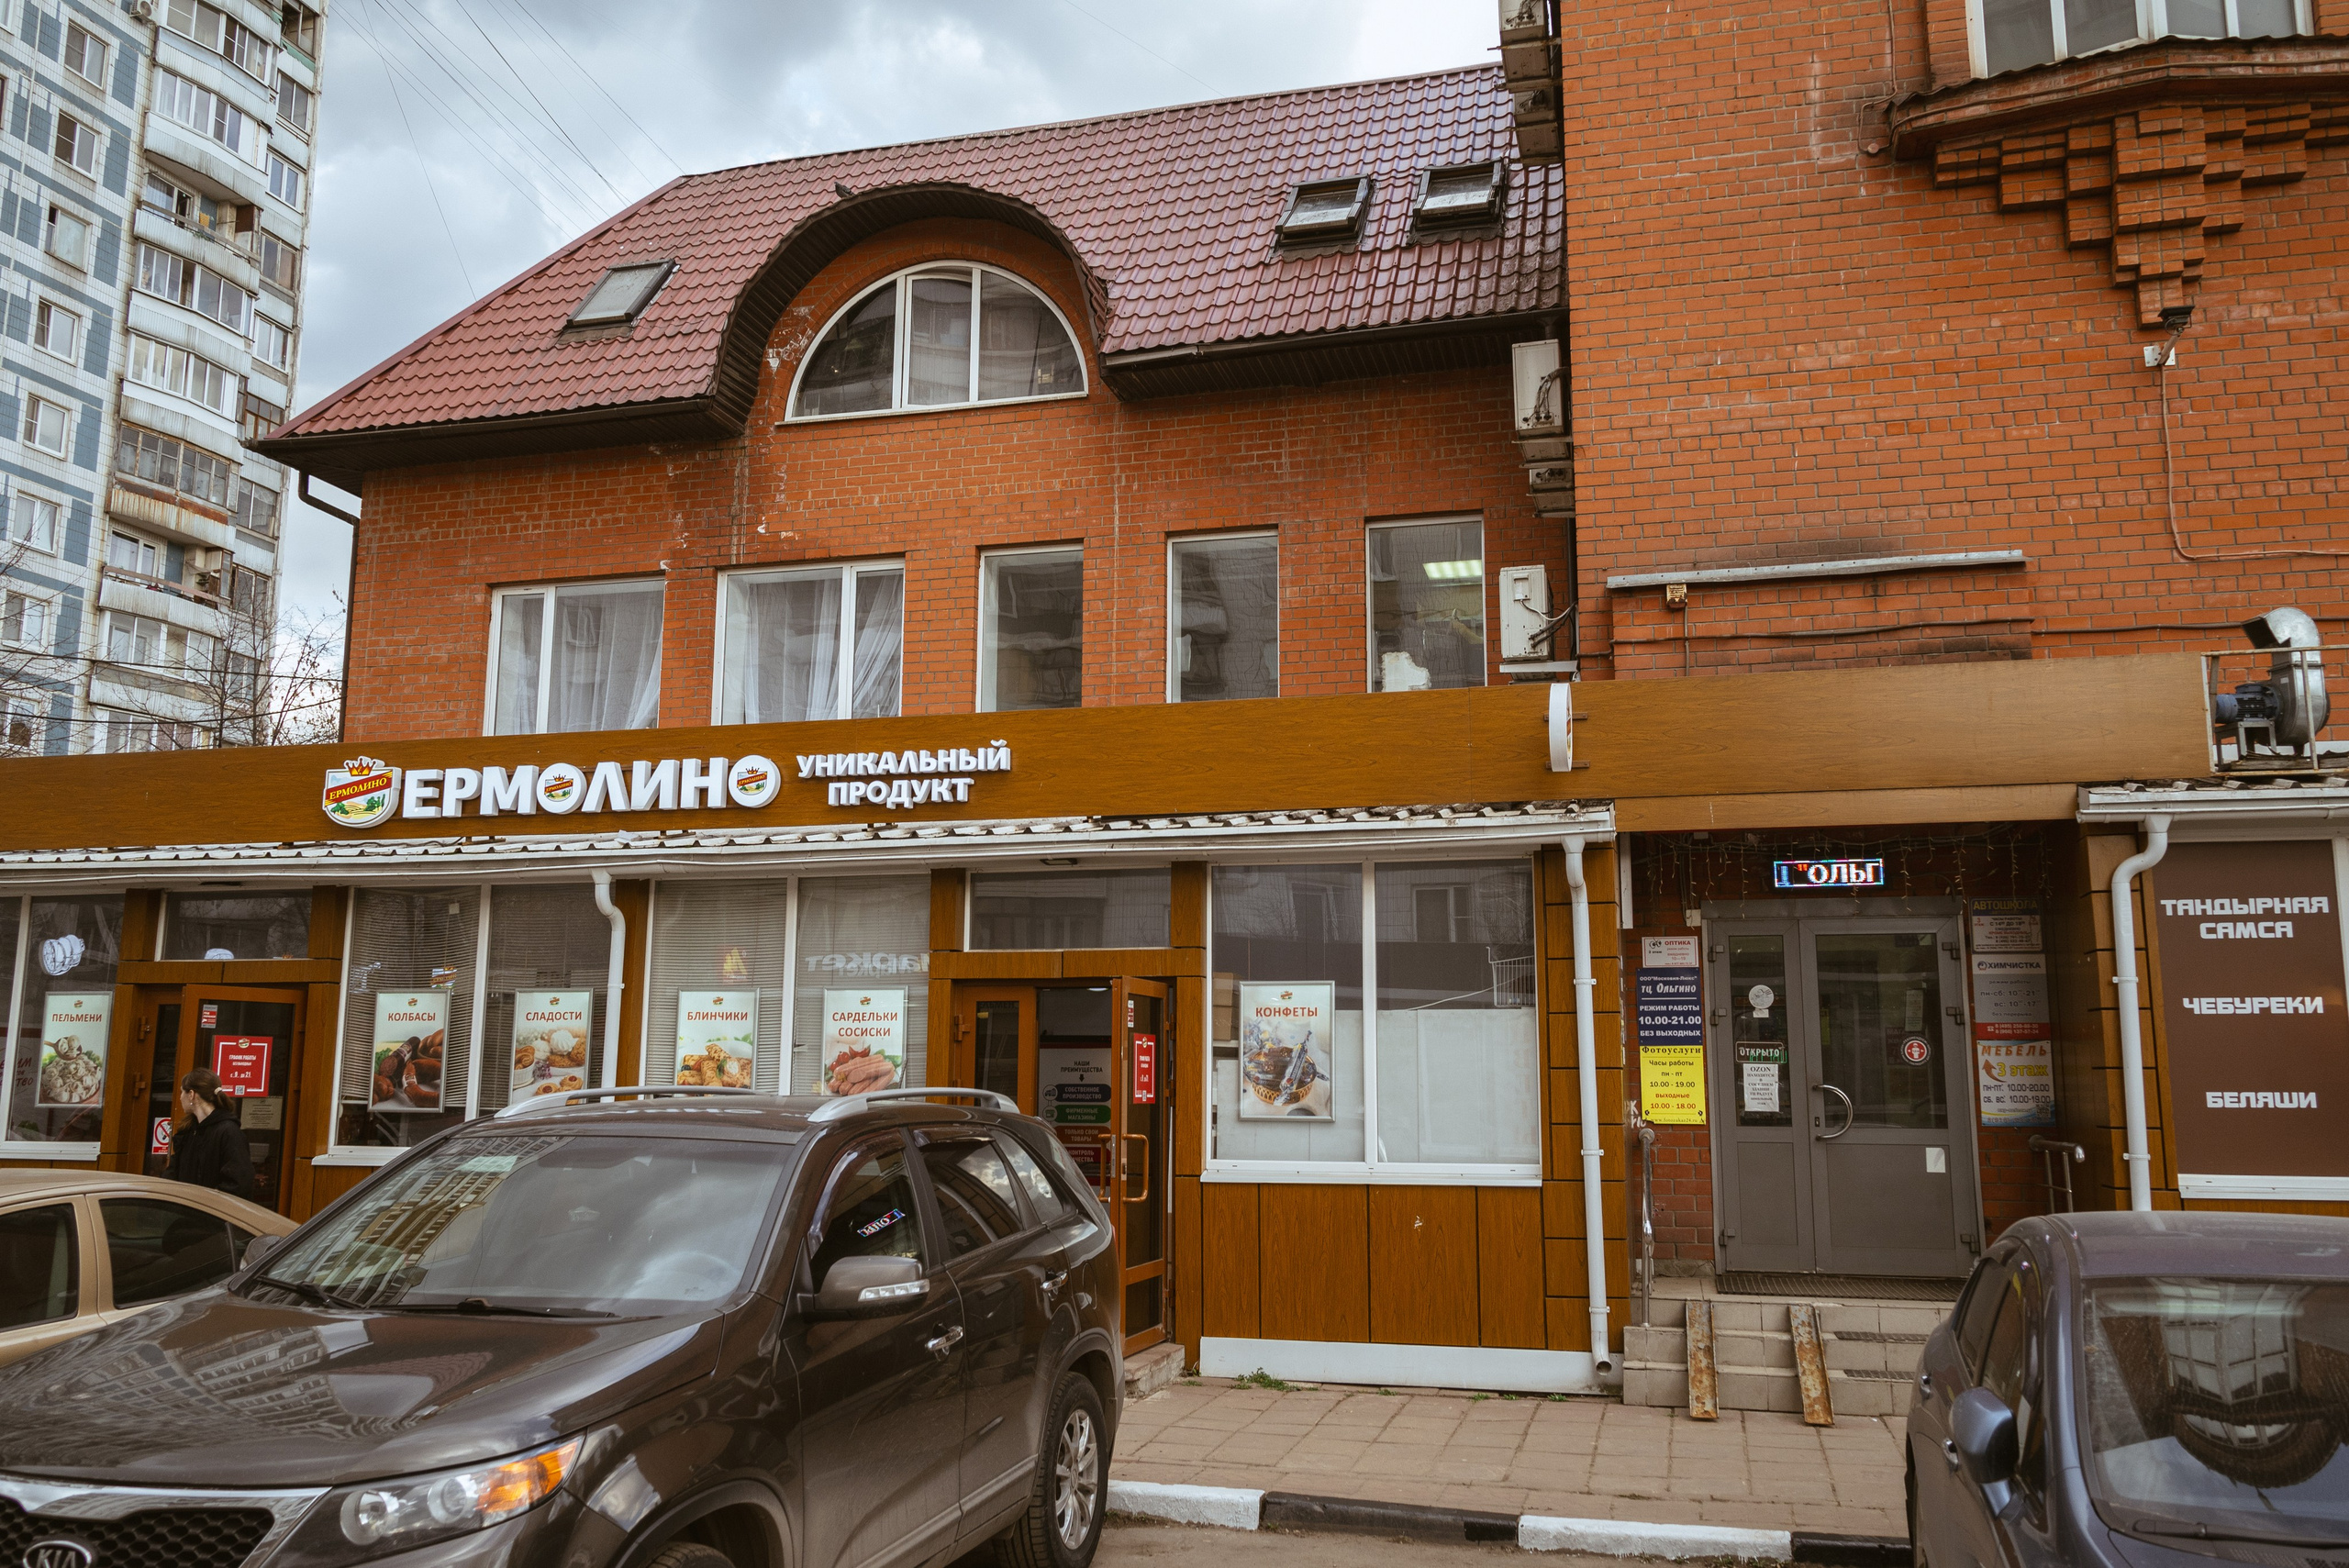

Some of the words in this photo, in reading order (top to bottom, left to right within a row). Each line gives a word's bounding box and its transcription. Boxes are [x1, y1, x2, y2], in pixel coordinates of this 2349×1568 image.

[796, 740, 1011, 778] УНИКАЛЬНЫЙ
[329, 777, 387, 800] ЕРМОЛИНО
[403, 755, 781, 818] ЕРМОЛИНО
[828, 778, 974, 810] ПРОДУКТ
[1974, 900, 2037, 910] АВТОШКОЛА
[2160, 897, 2329, 916] ТАНДЫРНАЯ
[2200, 922, 2293, 939] САМСА
[2182, 997, 2323, 1014] ЧЕБУРЕКИ
[388, 1012, 436, 1022] КОЛБАСЫ
[525, 1011, 582, 1023] СЛАДОСТИ
[687, 1011, 748, 1021] БЛИНЧИКИ
[832, 1012, 898, 1023] САРДЕЛЬКИ
[1256, 1007, 1318, 1017] КОНФЕТЫ
[52, 1013, 102, 1023] ПЕЛЬМЕНИ
[1639, 1016, 1702, 1025] 10.00-21.00
[838, 1028, 891, 1037] СОСИСКИ
[1642, 1046, 1701, 1055] Фотоуслуги
[1740, 1048, 1780, 1056] ОТКРЫТО
[1982, 1045, 2047, 1056] МЕБЕЛЬ
[1997, 1062, 2006, 1077] 3
[2009, 1065, 2049, 1077] этаж
[2206, 1092, 2317, 1108] БЕЛЯШИ
